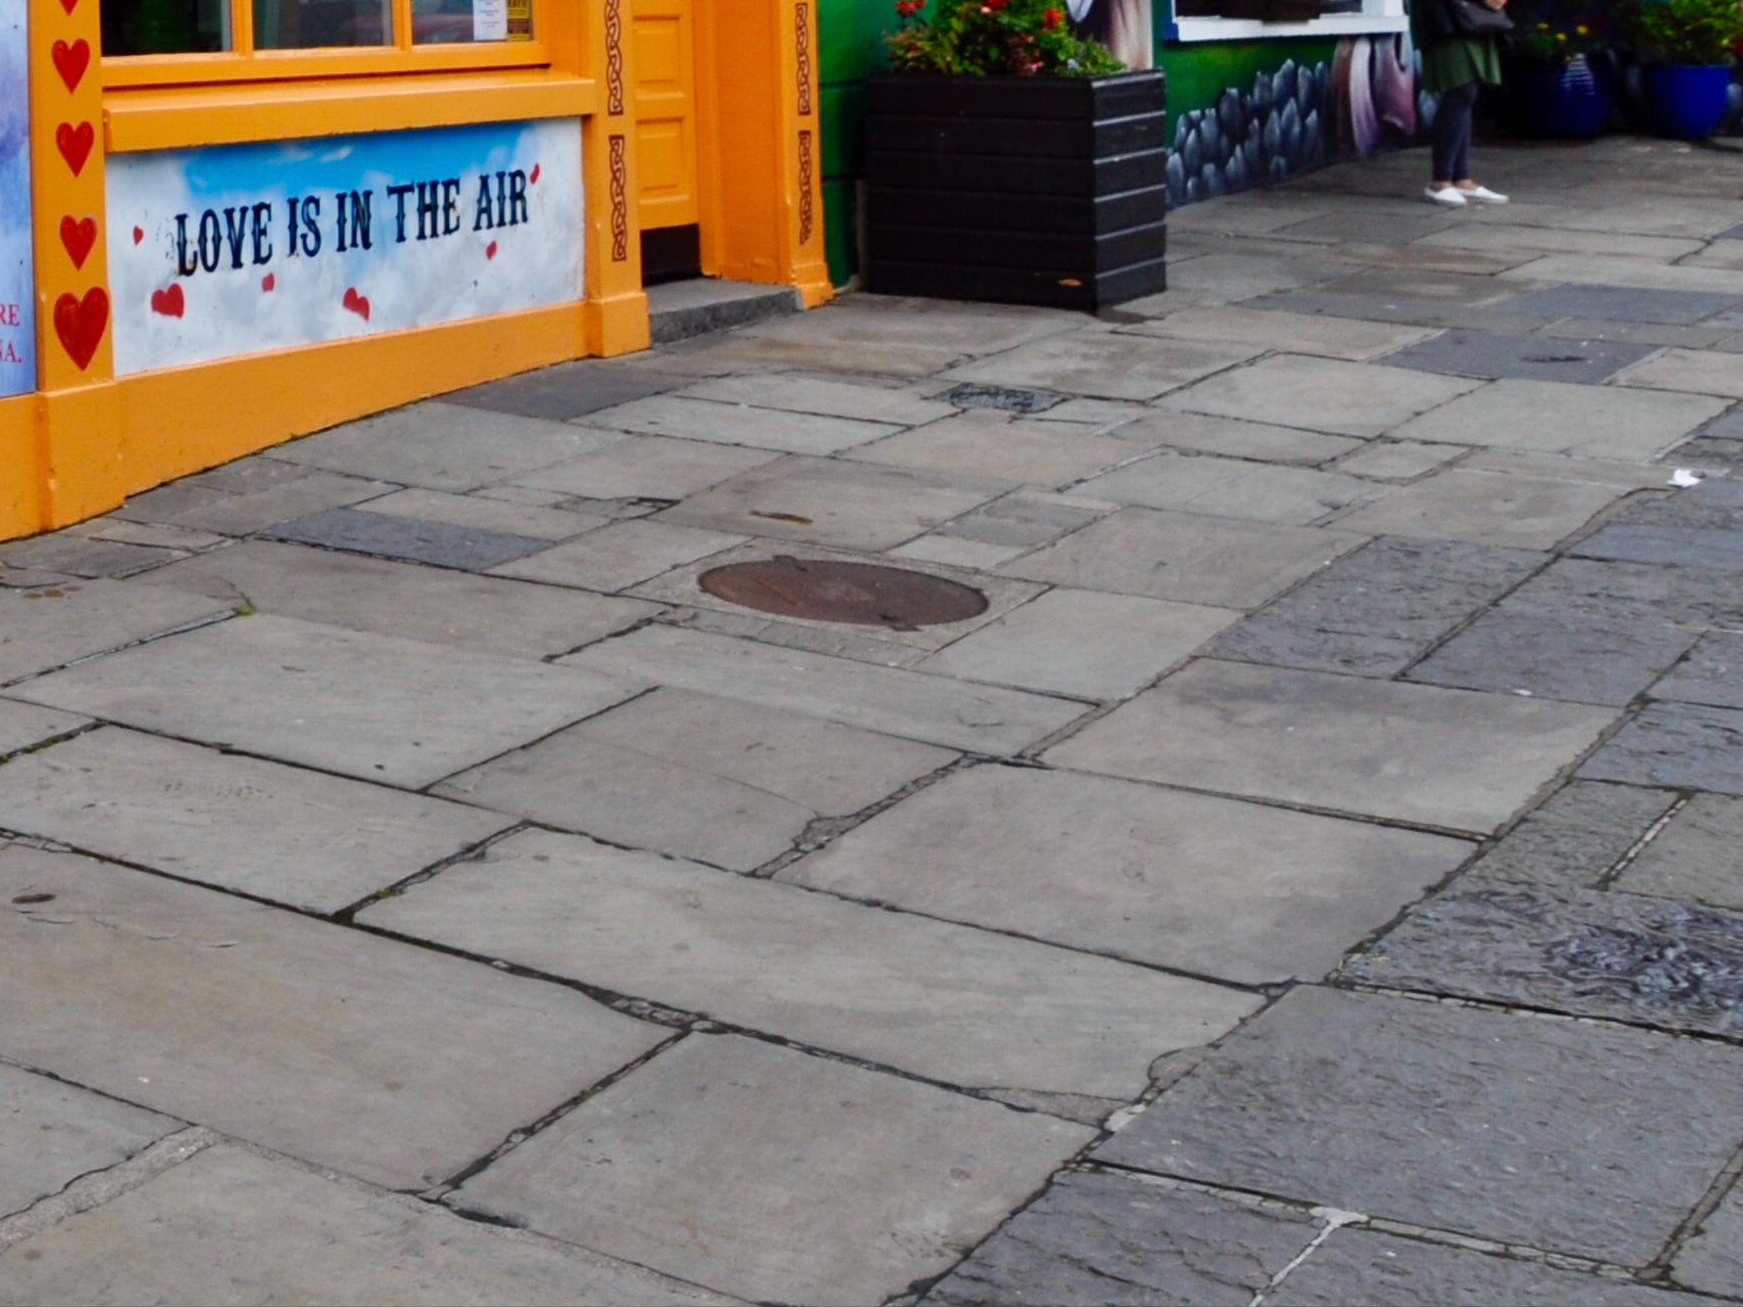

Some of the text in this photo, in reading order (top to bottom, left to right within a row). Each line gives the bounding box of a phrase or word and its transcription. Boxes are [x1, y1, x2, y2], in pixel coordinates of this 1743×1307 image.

[175, 169, 529, 276] LOVE IS IN THE AIR
